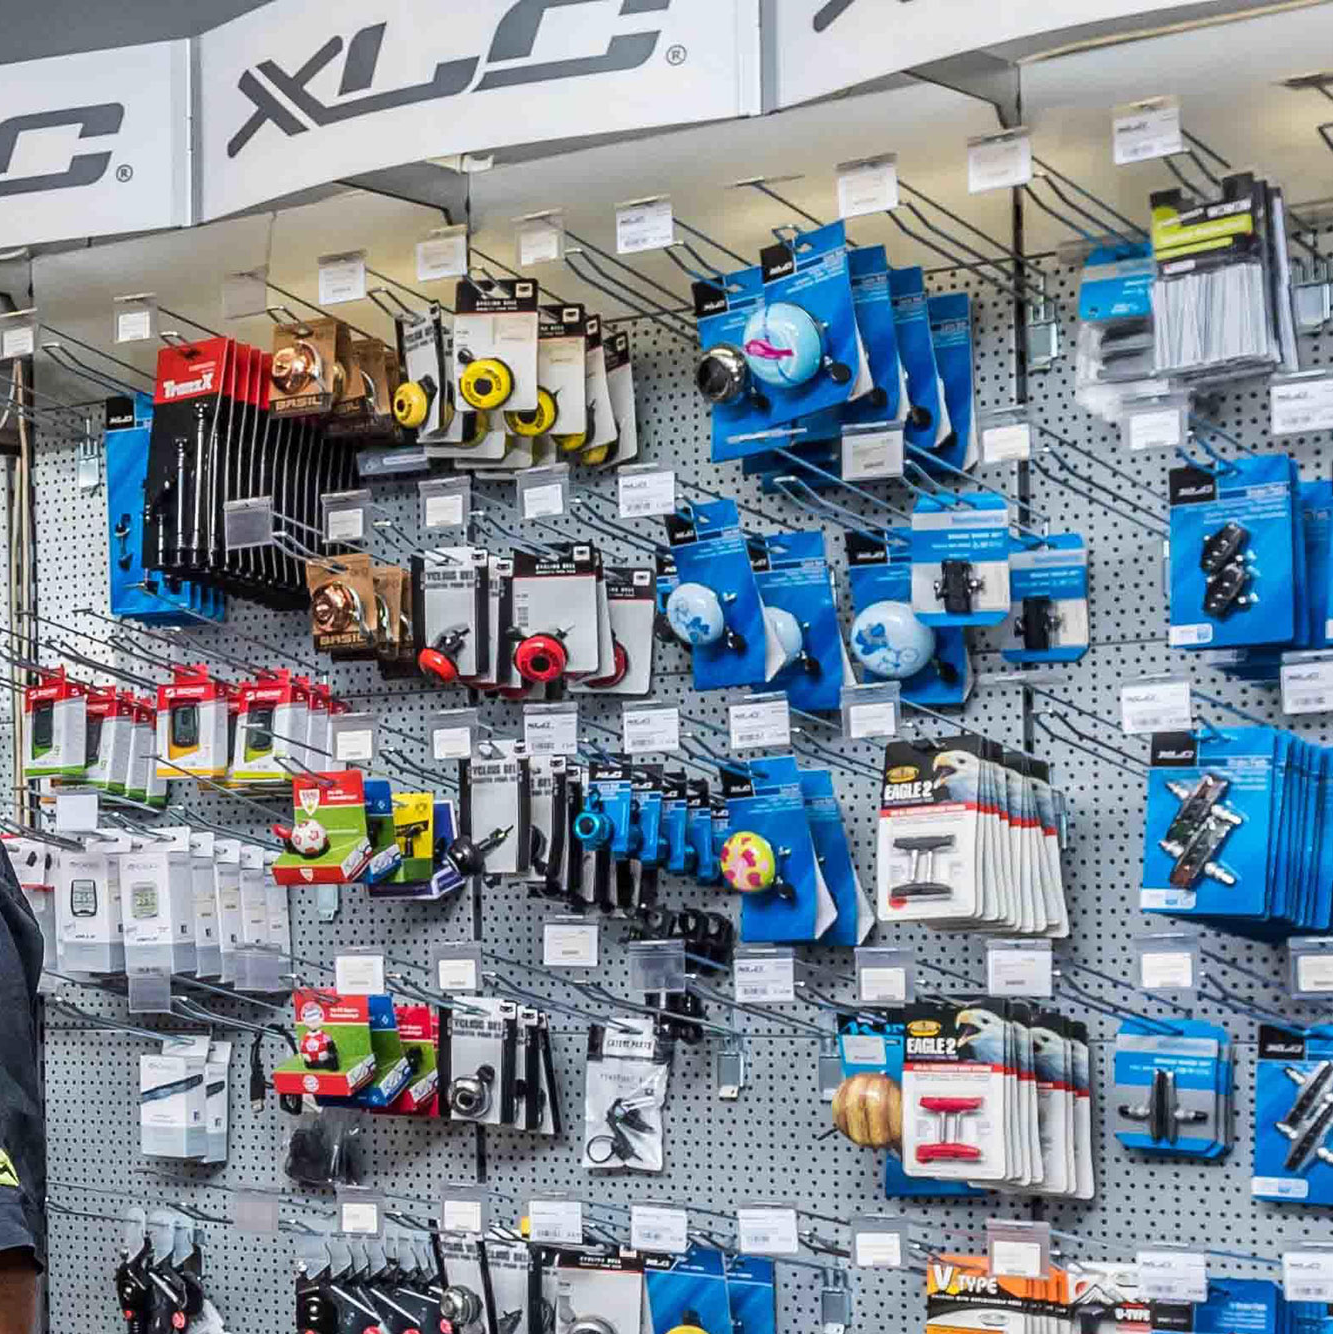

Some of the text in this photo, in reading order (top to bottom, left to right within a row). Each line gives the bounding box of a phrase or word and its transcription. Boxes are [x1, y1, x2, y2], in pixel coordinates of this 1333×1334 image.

[884, 780, 932, 800] EAGLE 2
[906, 1037, 957, 1055] EAGLE 2
